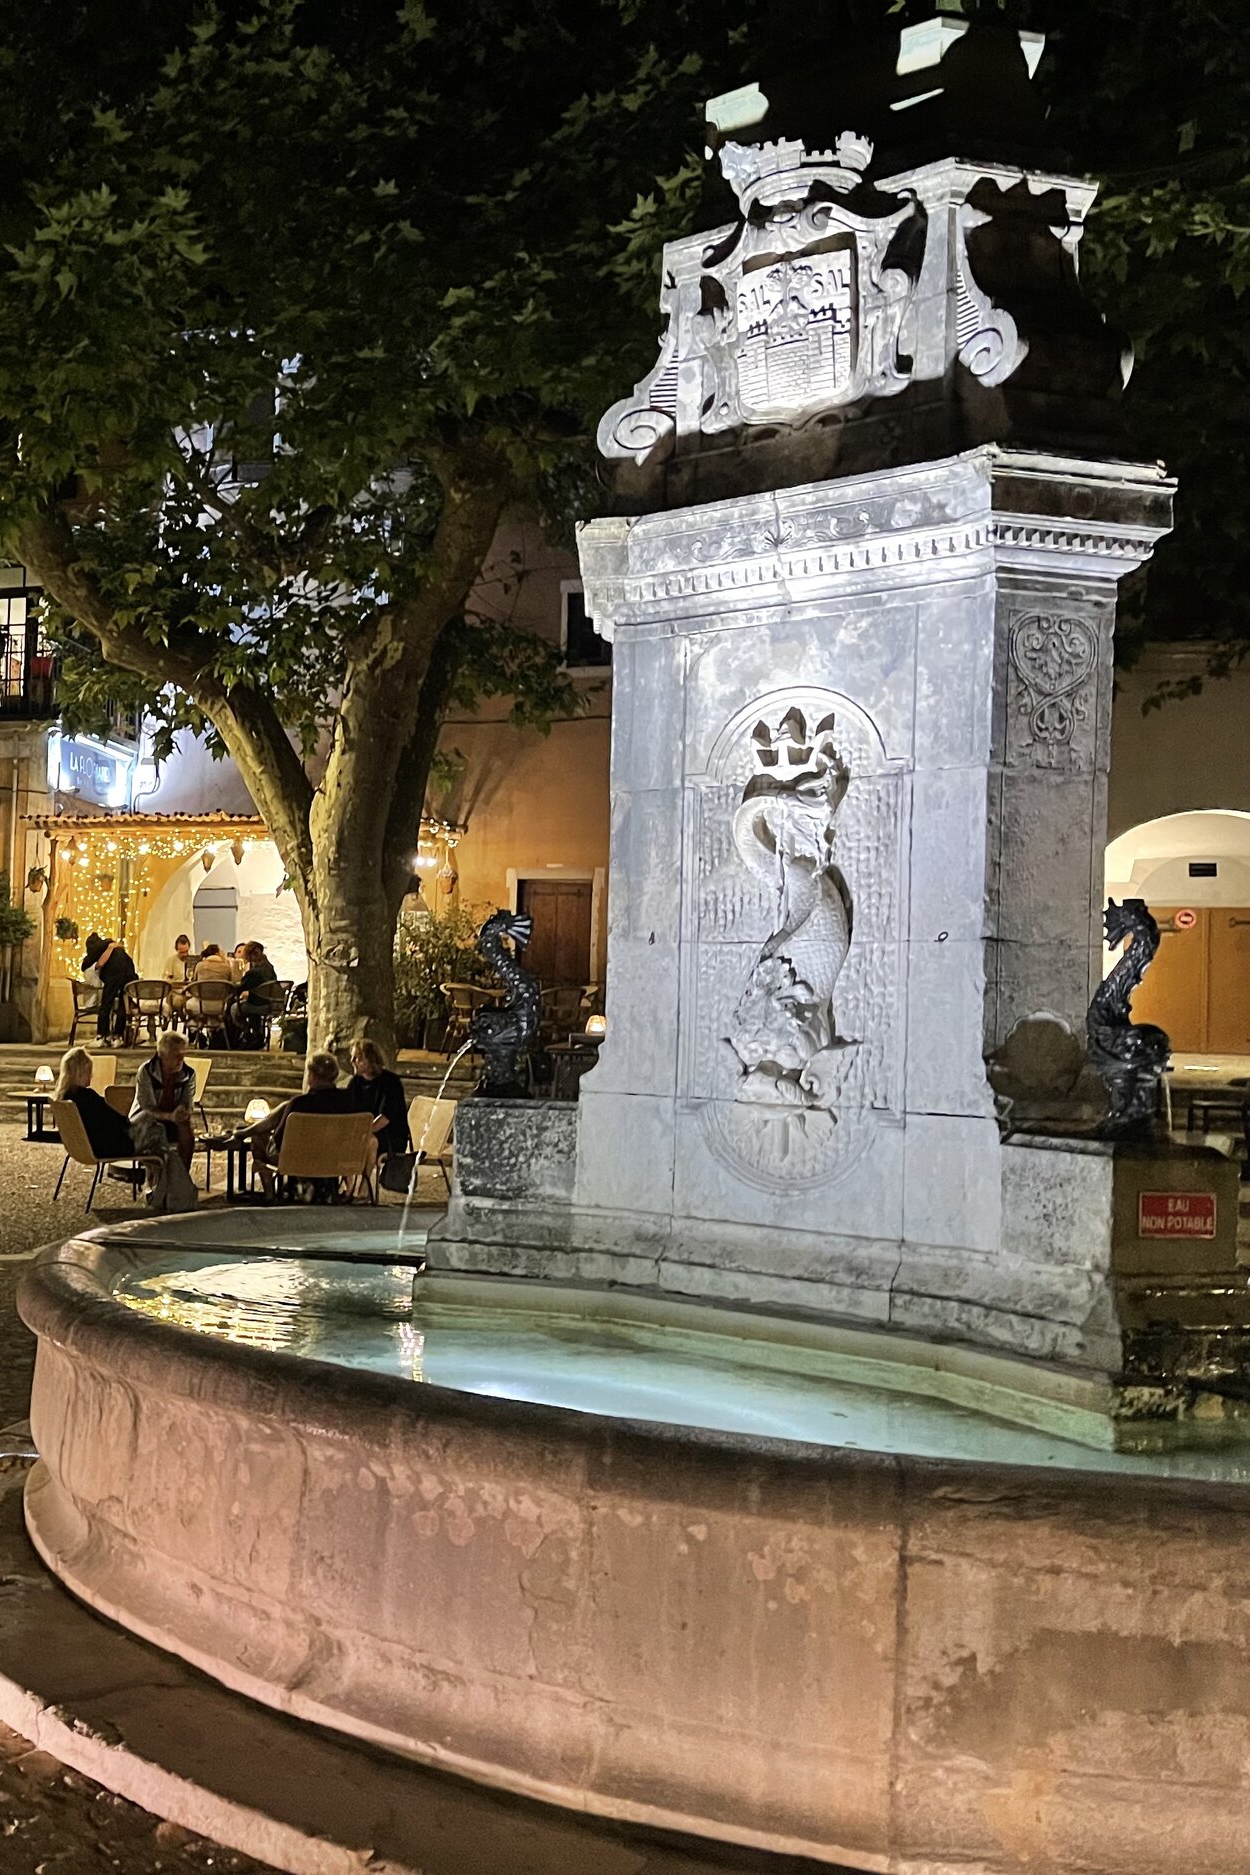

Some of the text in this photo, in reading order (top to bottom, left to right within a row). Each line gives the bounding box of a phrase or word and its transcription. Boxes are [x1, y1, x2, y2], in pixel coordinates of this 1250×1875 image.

[1167, 1198, 1190, 1213] EAU
[1142, 1216, 1214, 1230] NON POTABLE
